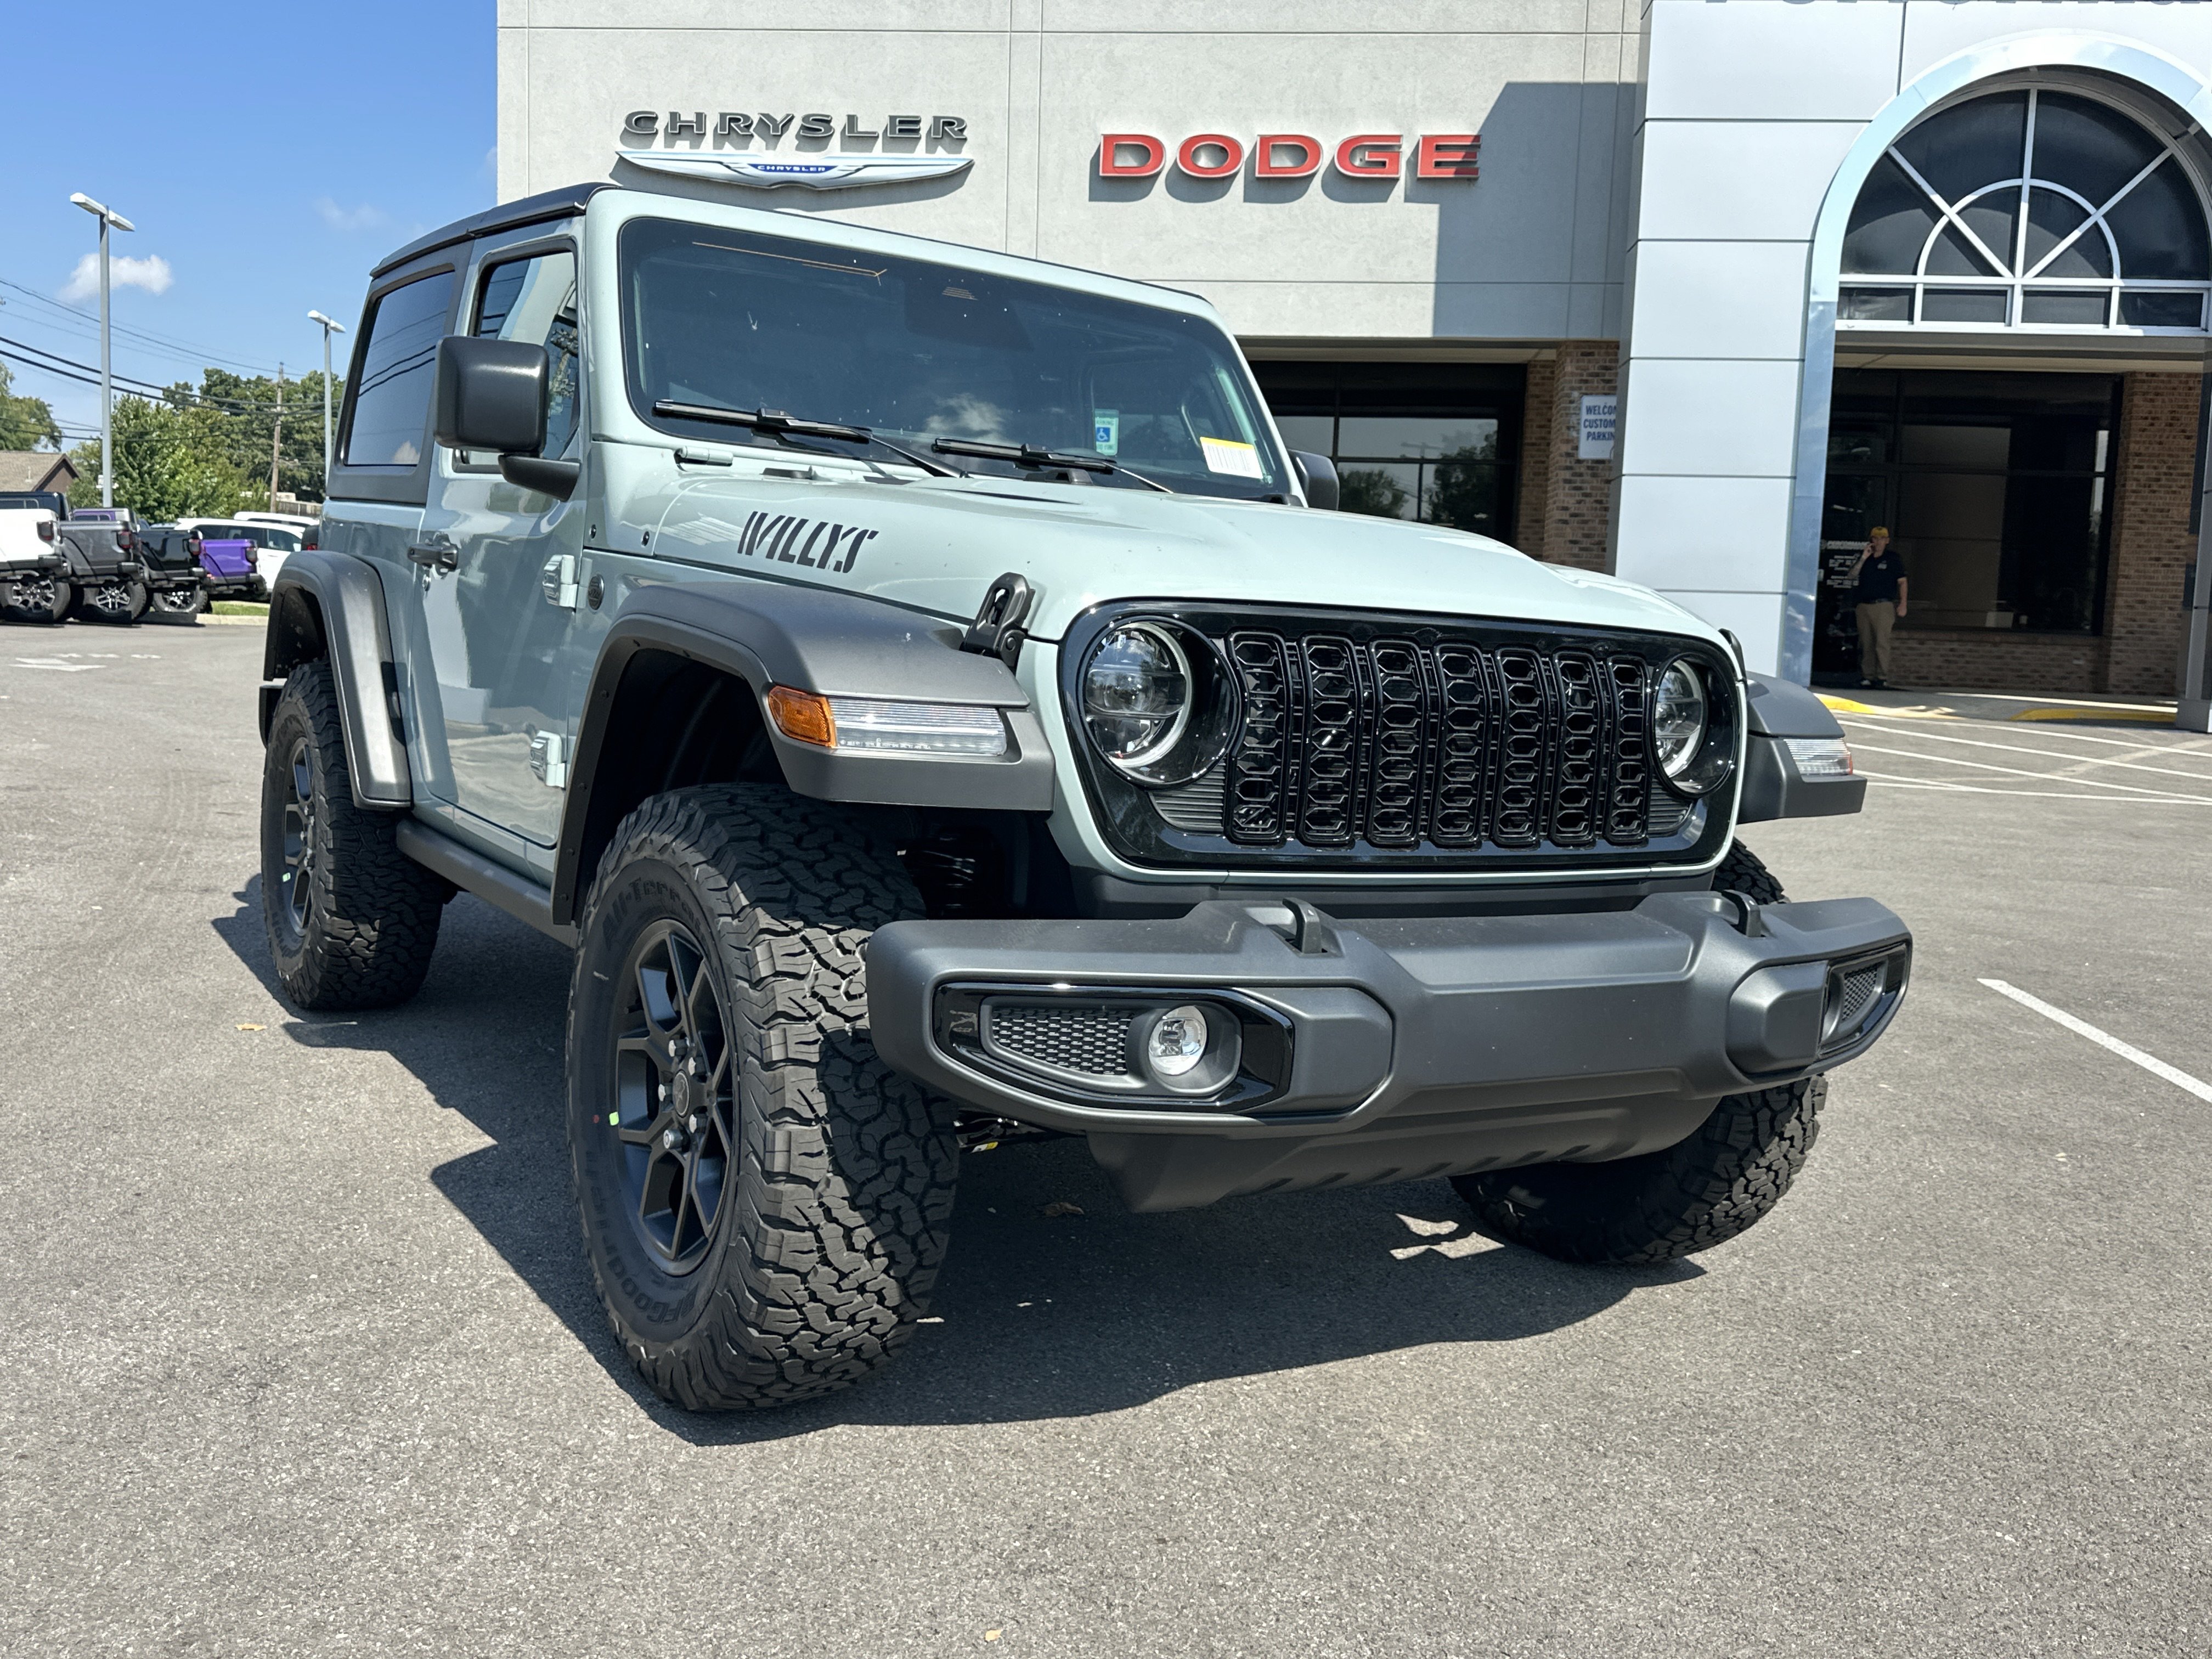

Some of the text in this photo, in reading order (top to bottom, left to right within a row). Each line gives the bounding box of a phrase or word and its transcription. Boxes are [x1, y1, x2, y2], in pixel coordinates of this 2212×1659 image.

[624, 110, 968, 140] CHRYSLER
[1099, 134, 1483, 179] DODGE
[737, 511, 879, 573] WILLYS
